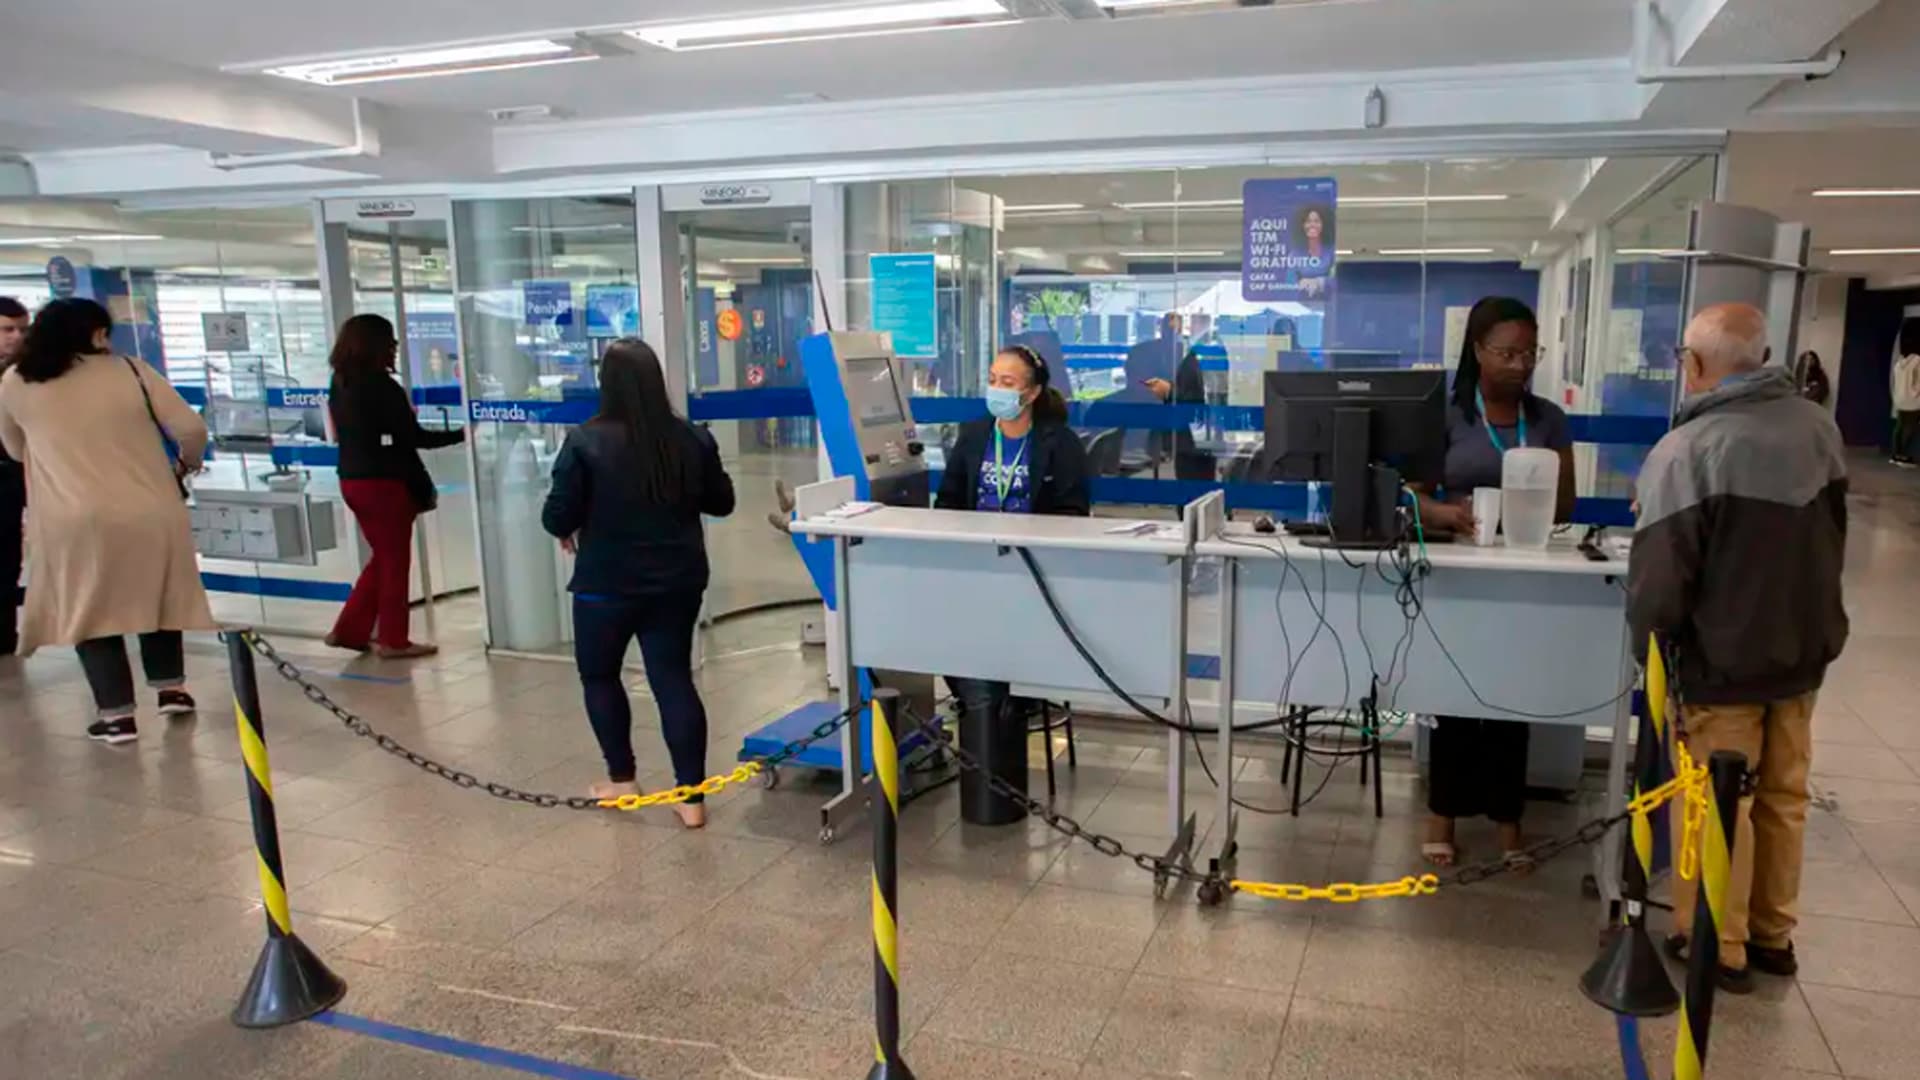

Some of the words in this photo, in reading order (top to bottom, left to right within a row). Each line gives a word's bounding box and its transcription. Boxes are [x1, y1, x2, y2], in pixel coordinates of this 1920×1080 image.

[1249, 218, 1288, 231] AQUI
[1250, 231, 1278, 243] TEM
[1250, 244, 1287, 256] WI-FI
[1249, 256, 1321, 268] GRATUITO
[470, 402, 527, 420] Entrada
